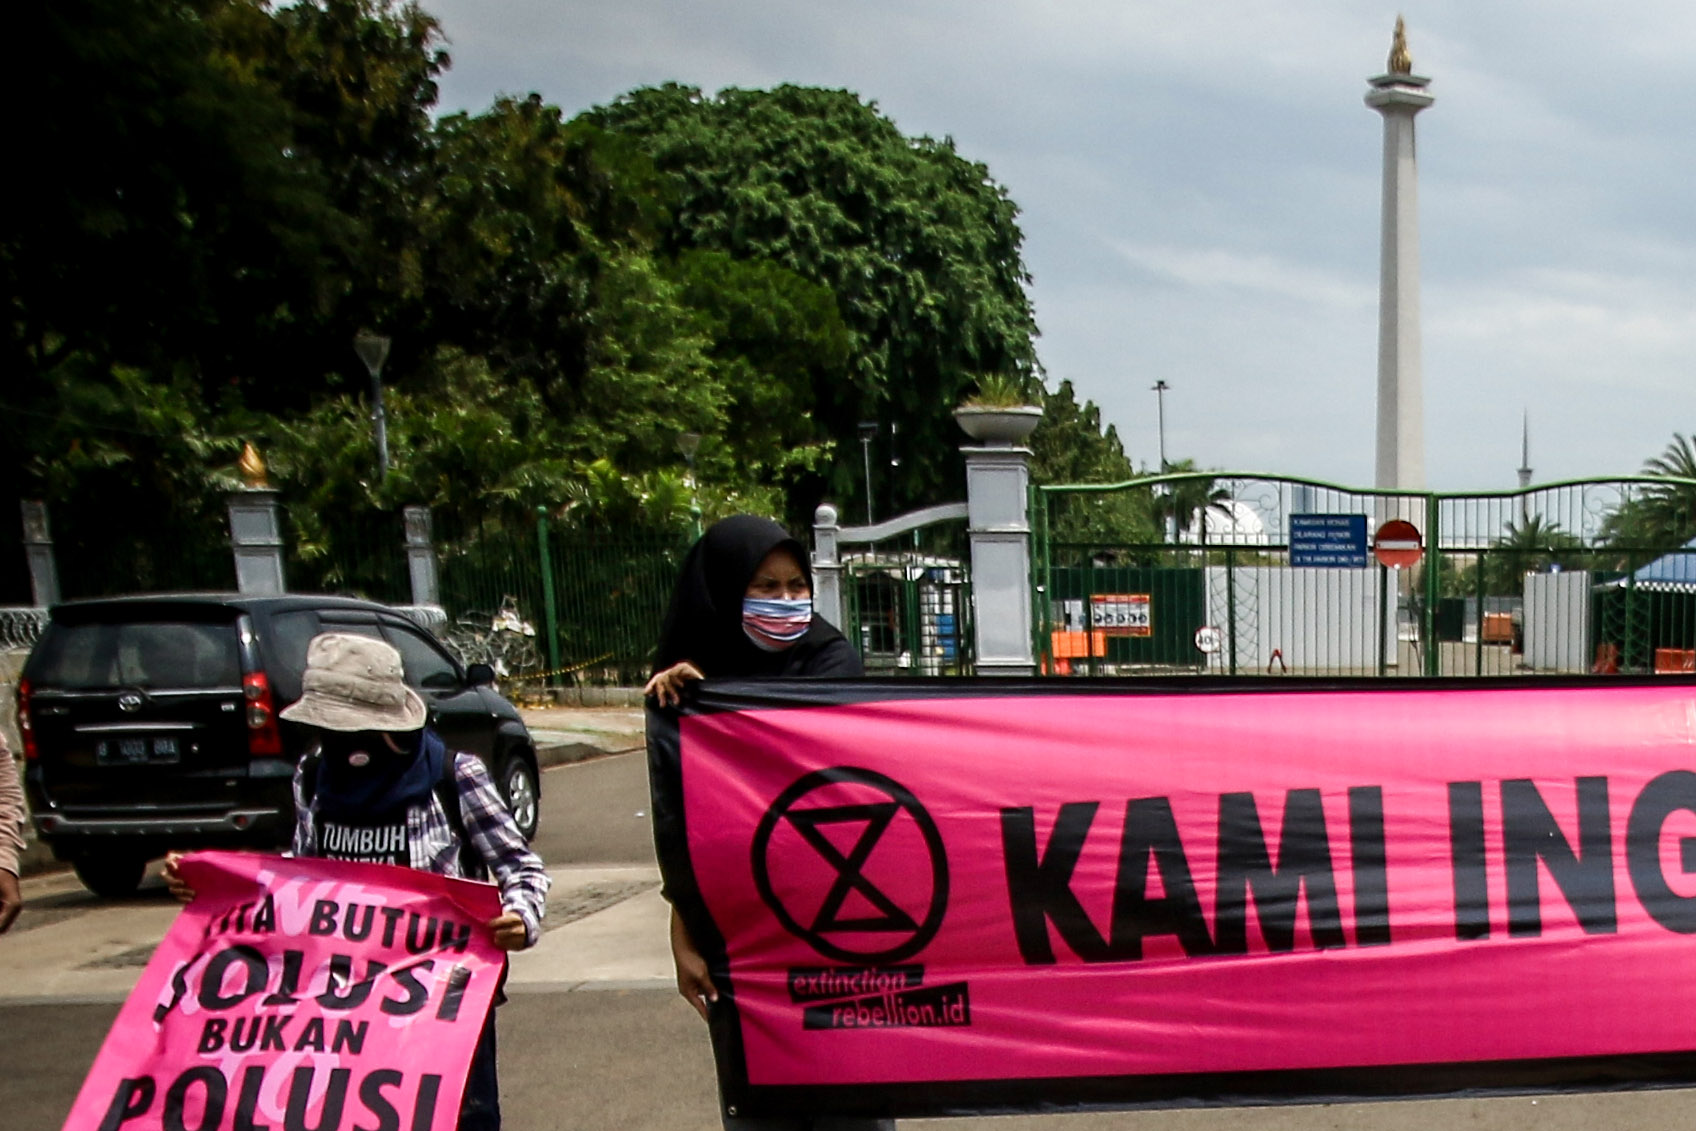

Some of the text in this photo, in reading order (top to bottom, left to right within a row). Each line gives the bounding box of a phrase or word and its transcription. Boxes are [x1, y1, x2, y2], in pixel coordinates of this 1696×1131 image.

[323, 823, 405, 853] TUMBUH
[1000, 784, 1391, 966] KAMI
[309, 900, 471, 954] BUTUH
[793, 968, 907, 994] extinction
[832, 992, 965, 1026] rebellion.id
[197, 1014, 369, 1055] BUKAN
